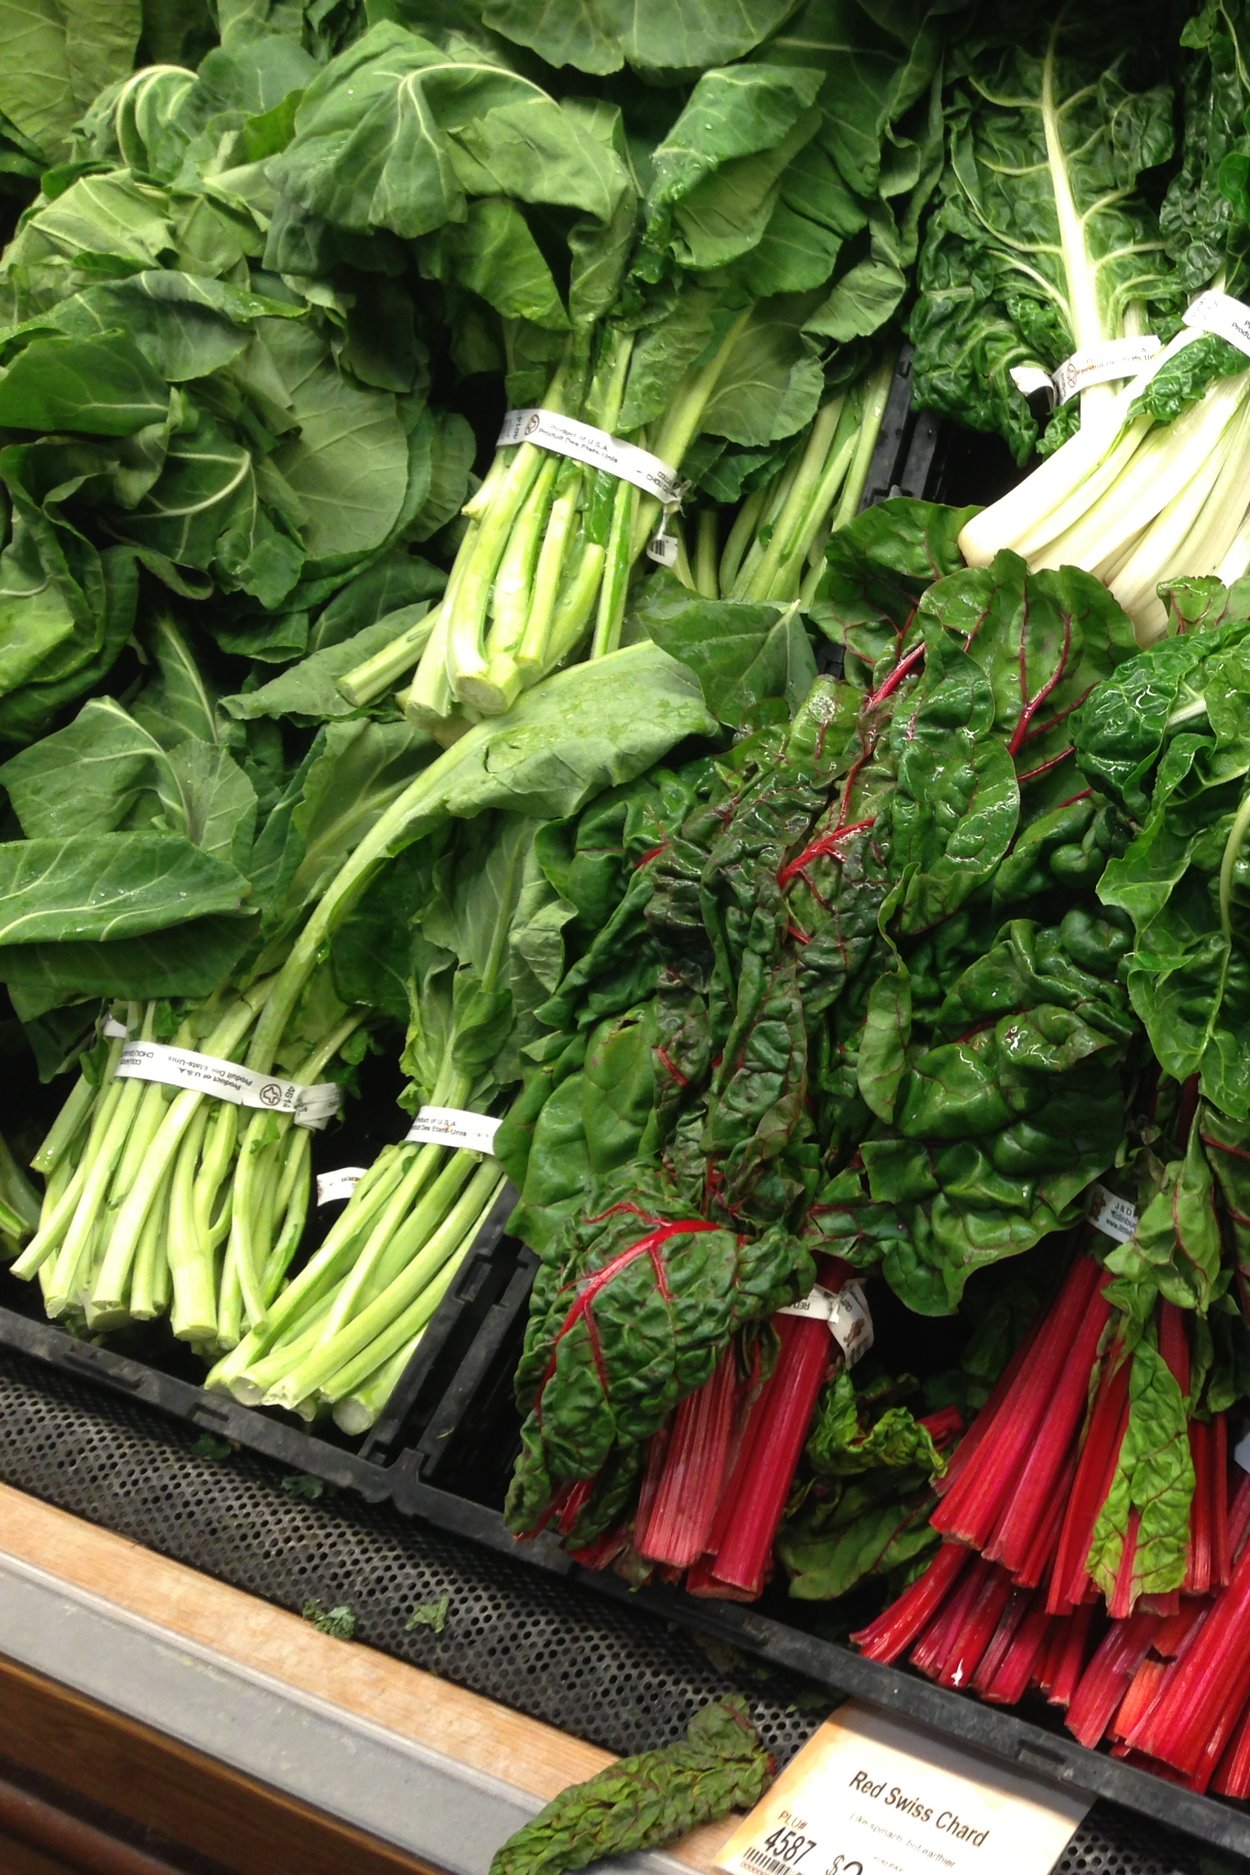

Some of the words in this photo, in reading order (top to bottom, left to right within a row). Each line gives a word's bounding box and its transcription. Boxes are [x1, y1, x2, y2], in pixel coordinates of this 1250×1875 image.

[213, 1076, 242, 1091] Product
[228, 1072, 253, 1087] Produit
[849, 1771, 888, 1799] Red
[885, 1787, 934, 1823] Swiss
[935, 1811, 990, 1848] Chard
[778, 1810, 808, 1831] PLU#
[764, 1826, 818, 1866] 4587
